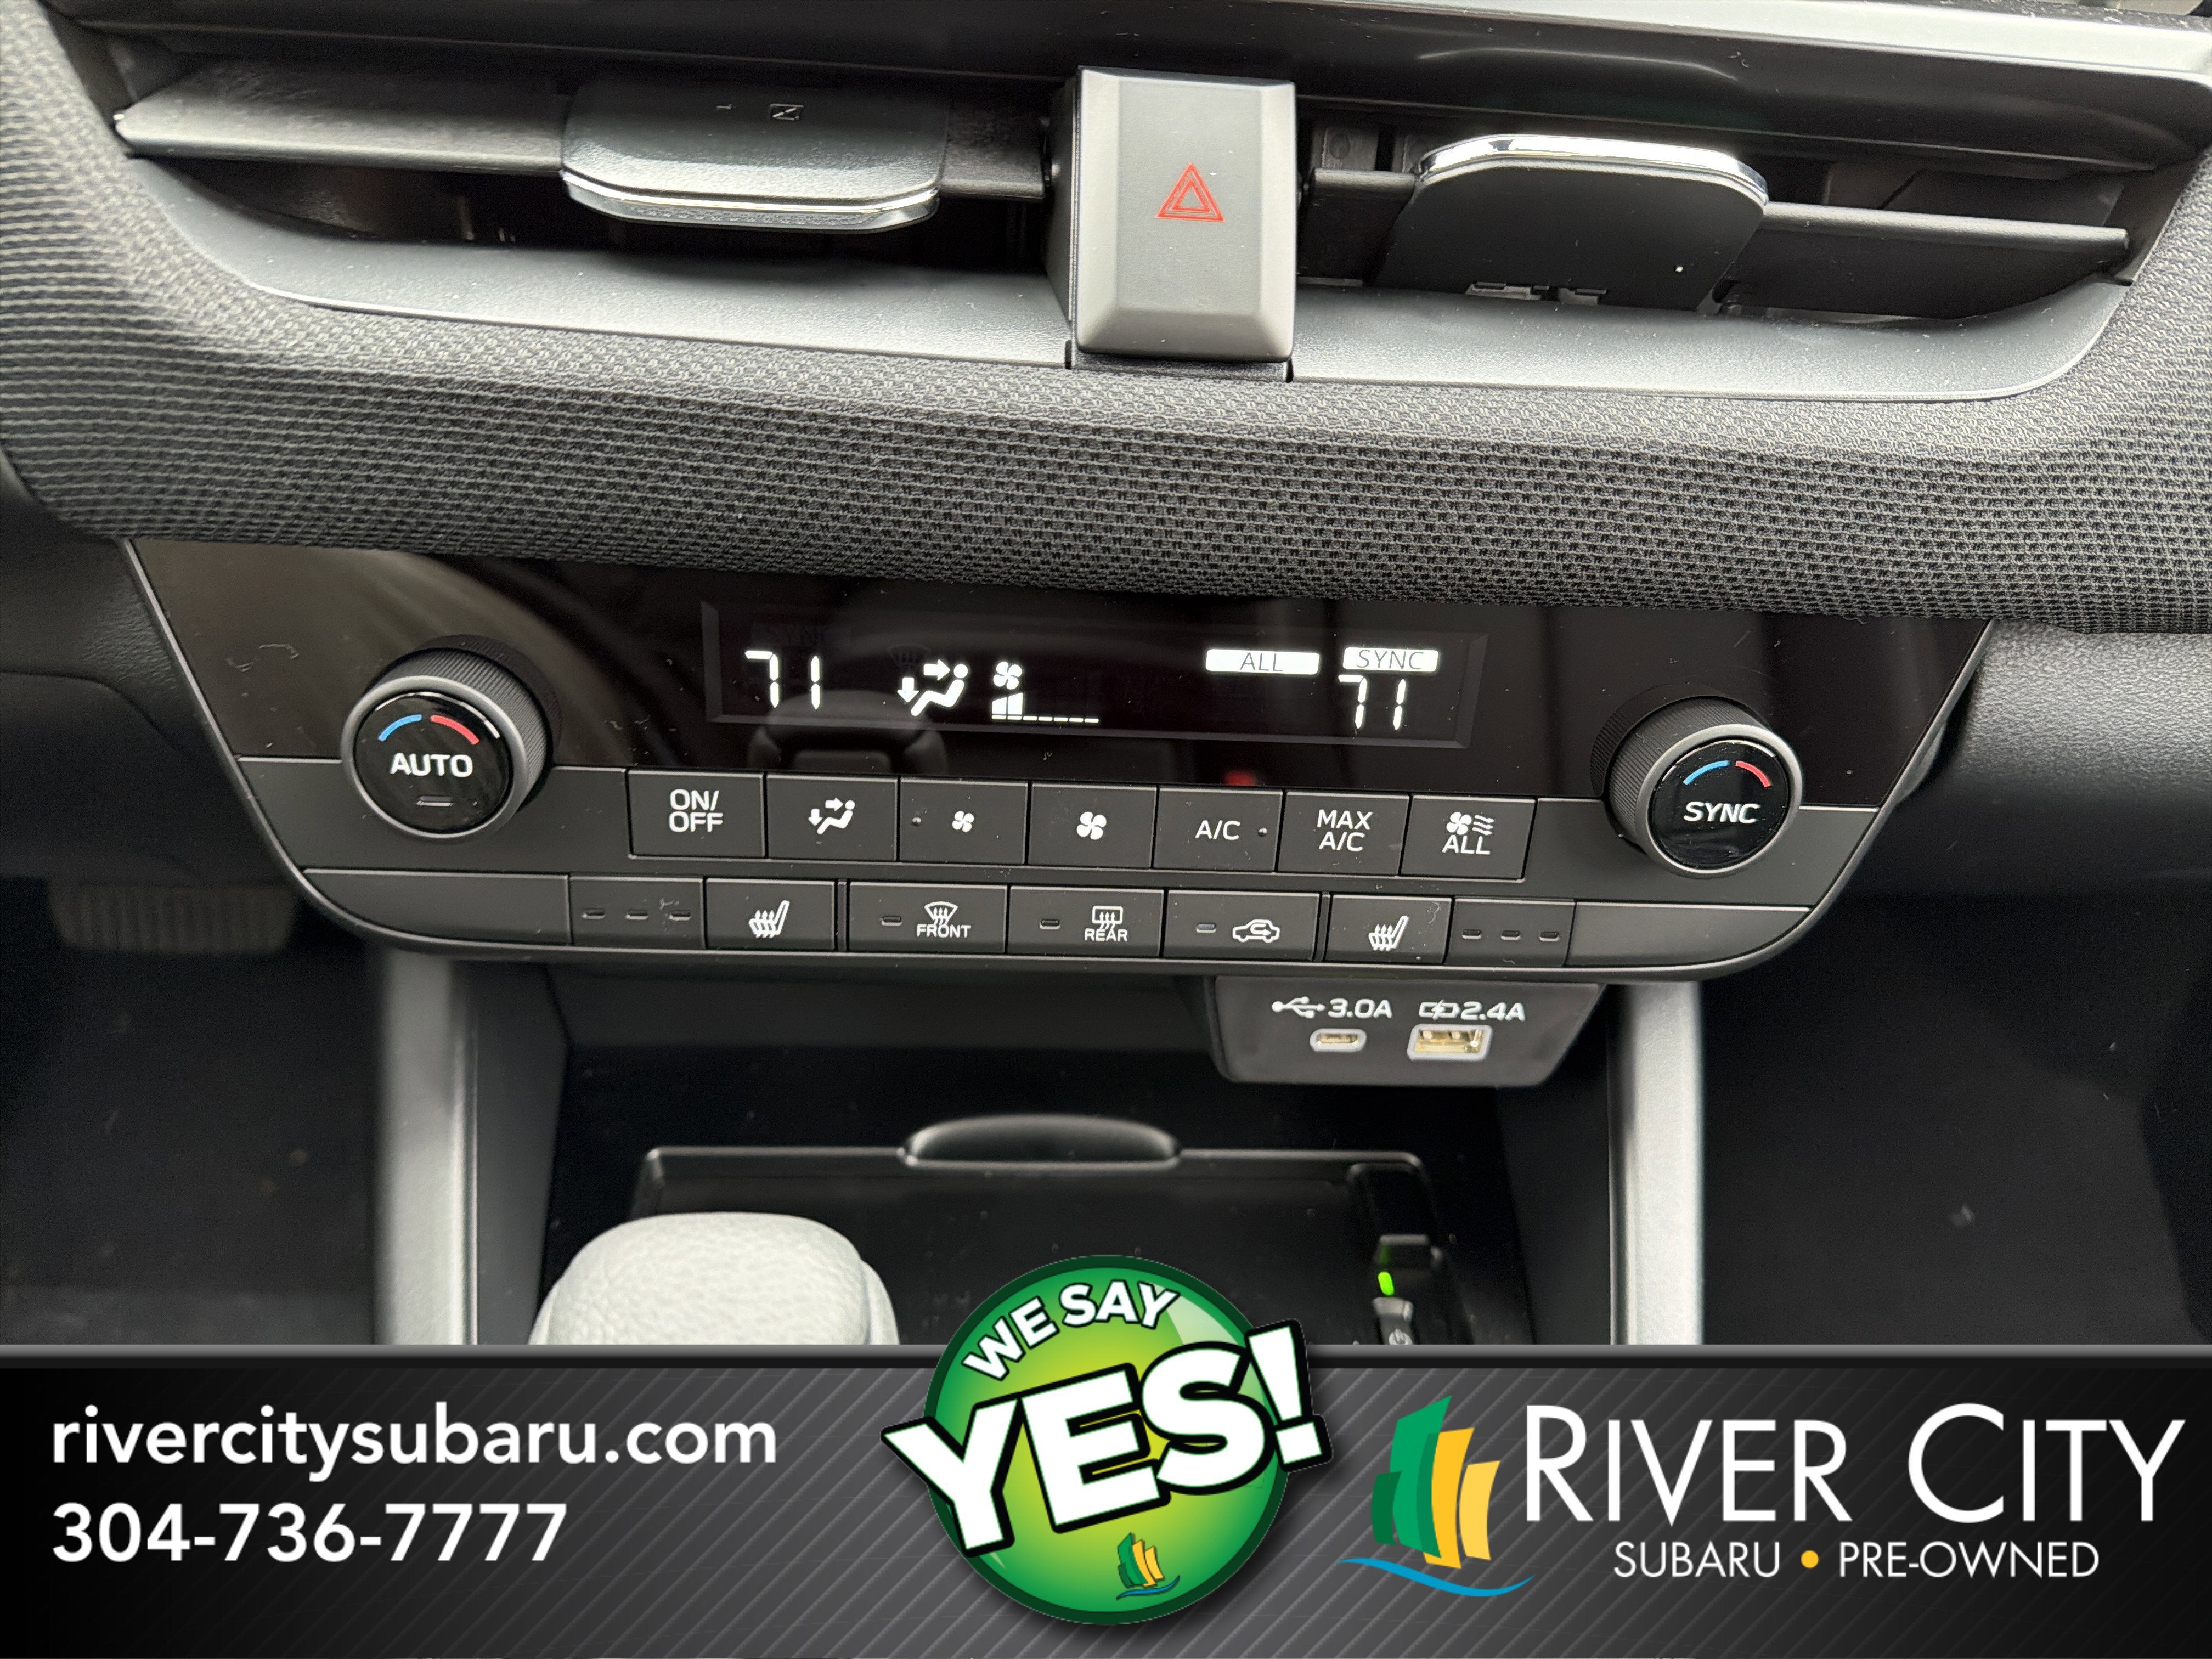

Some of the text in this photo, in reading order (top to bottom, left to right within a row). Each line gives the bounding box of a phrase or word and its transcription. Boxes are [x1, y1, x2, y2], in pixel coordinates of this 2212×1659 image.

[1239, 652, 1284, 672] ALL
[1357, 648, 1424, 670] SYNC
[744, 650, 821, 710] 71
[1338, 674, 1407, 730] 71
[390, 752, 473, 777] AUTO
[669, 789, 720, 811] ON/
[669, 811, 724, 833] OFF
[1317, 809, 1373, 831] MAX
[1683, 801, 1760, 824] SYNC
[1195, 820, 1241, 840] A/C
[1318, 831, 1365, 852] A/C
[1442, 835, 1491, 855] ALL
[916, 924, 972, 939] FRONT
[1084, 928, 1128, 942] REAR
[1328, 998, 1393, 1019] 3.0A
[1462, 1001, 1526, 1022] 2.4A
